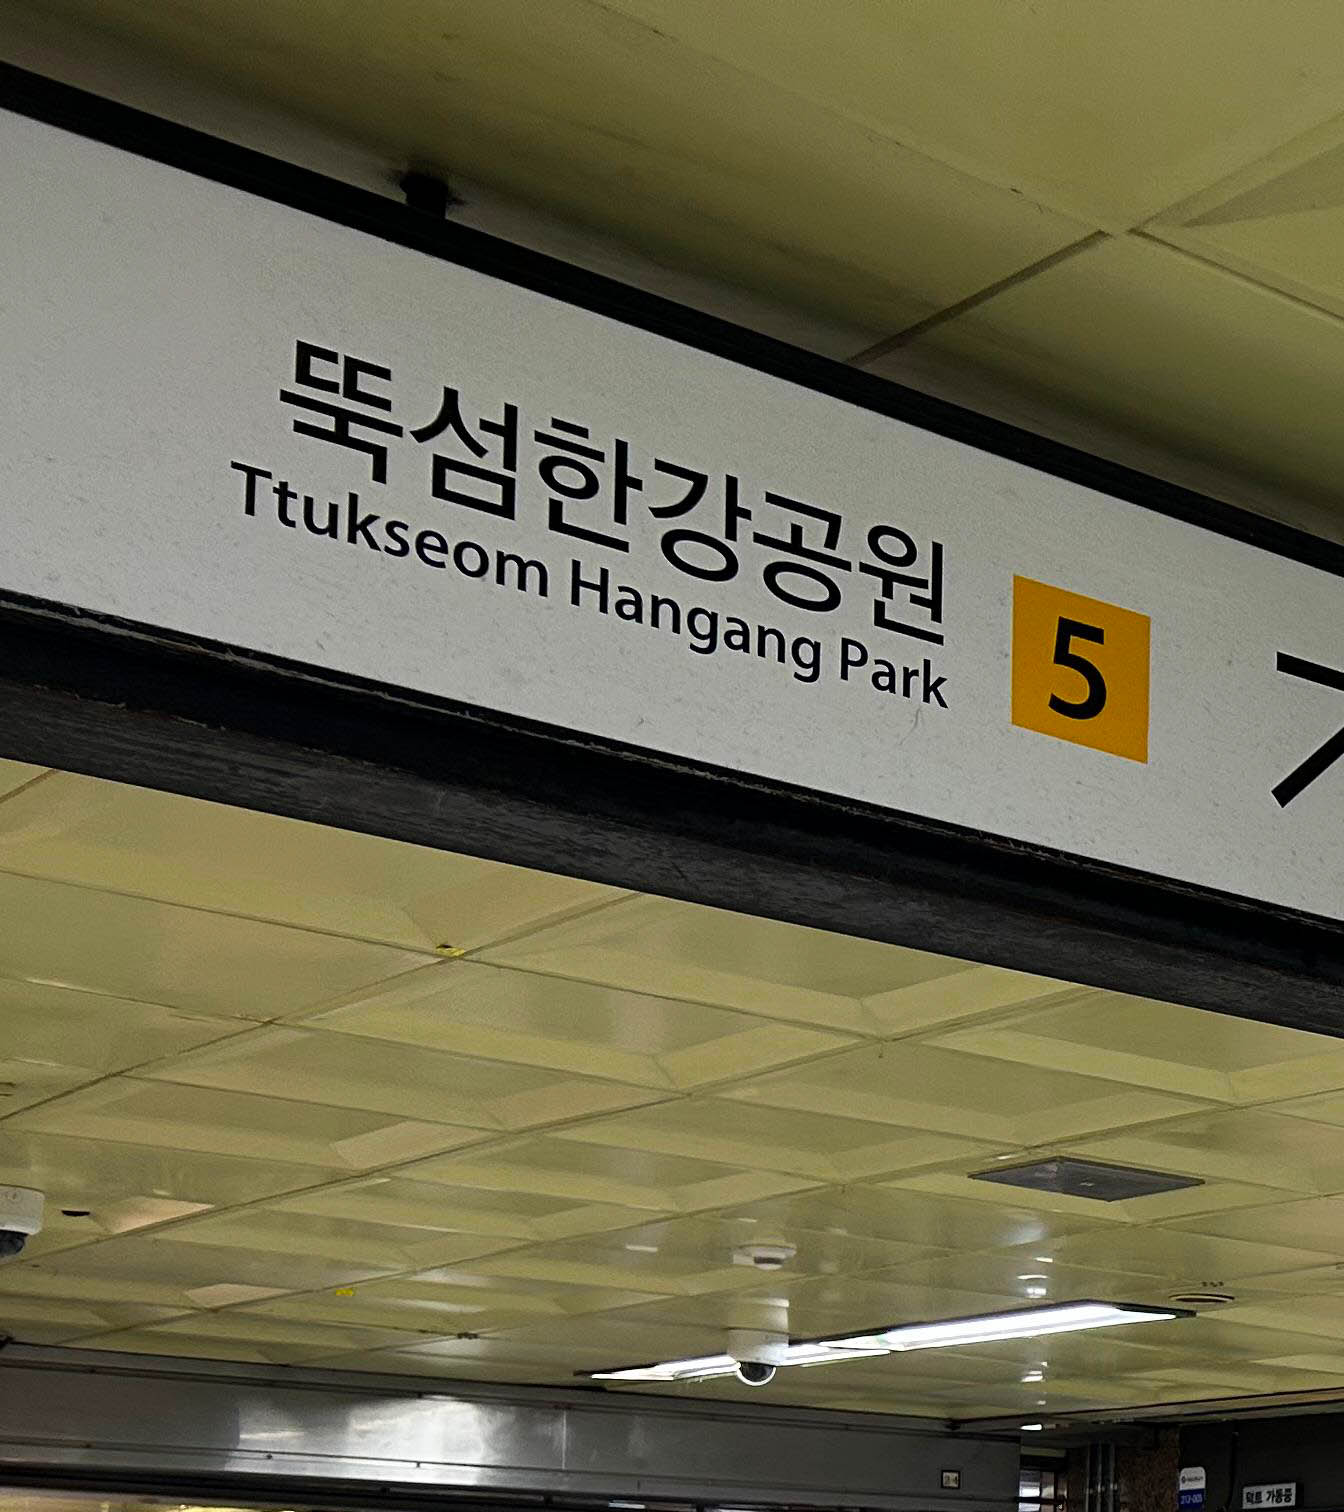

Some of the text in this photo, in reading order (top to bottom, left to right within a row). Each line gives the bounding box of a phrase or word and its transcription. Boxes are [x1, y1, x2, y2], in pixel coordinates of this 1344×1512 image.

[230, 461, 950, 709] Ttukseom Hangang Park
[280, 340, 946, 646] 뚝섬한강공원
[1048, 615, 1107, 720] 5
